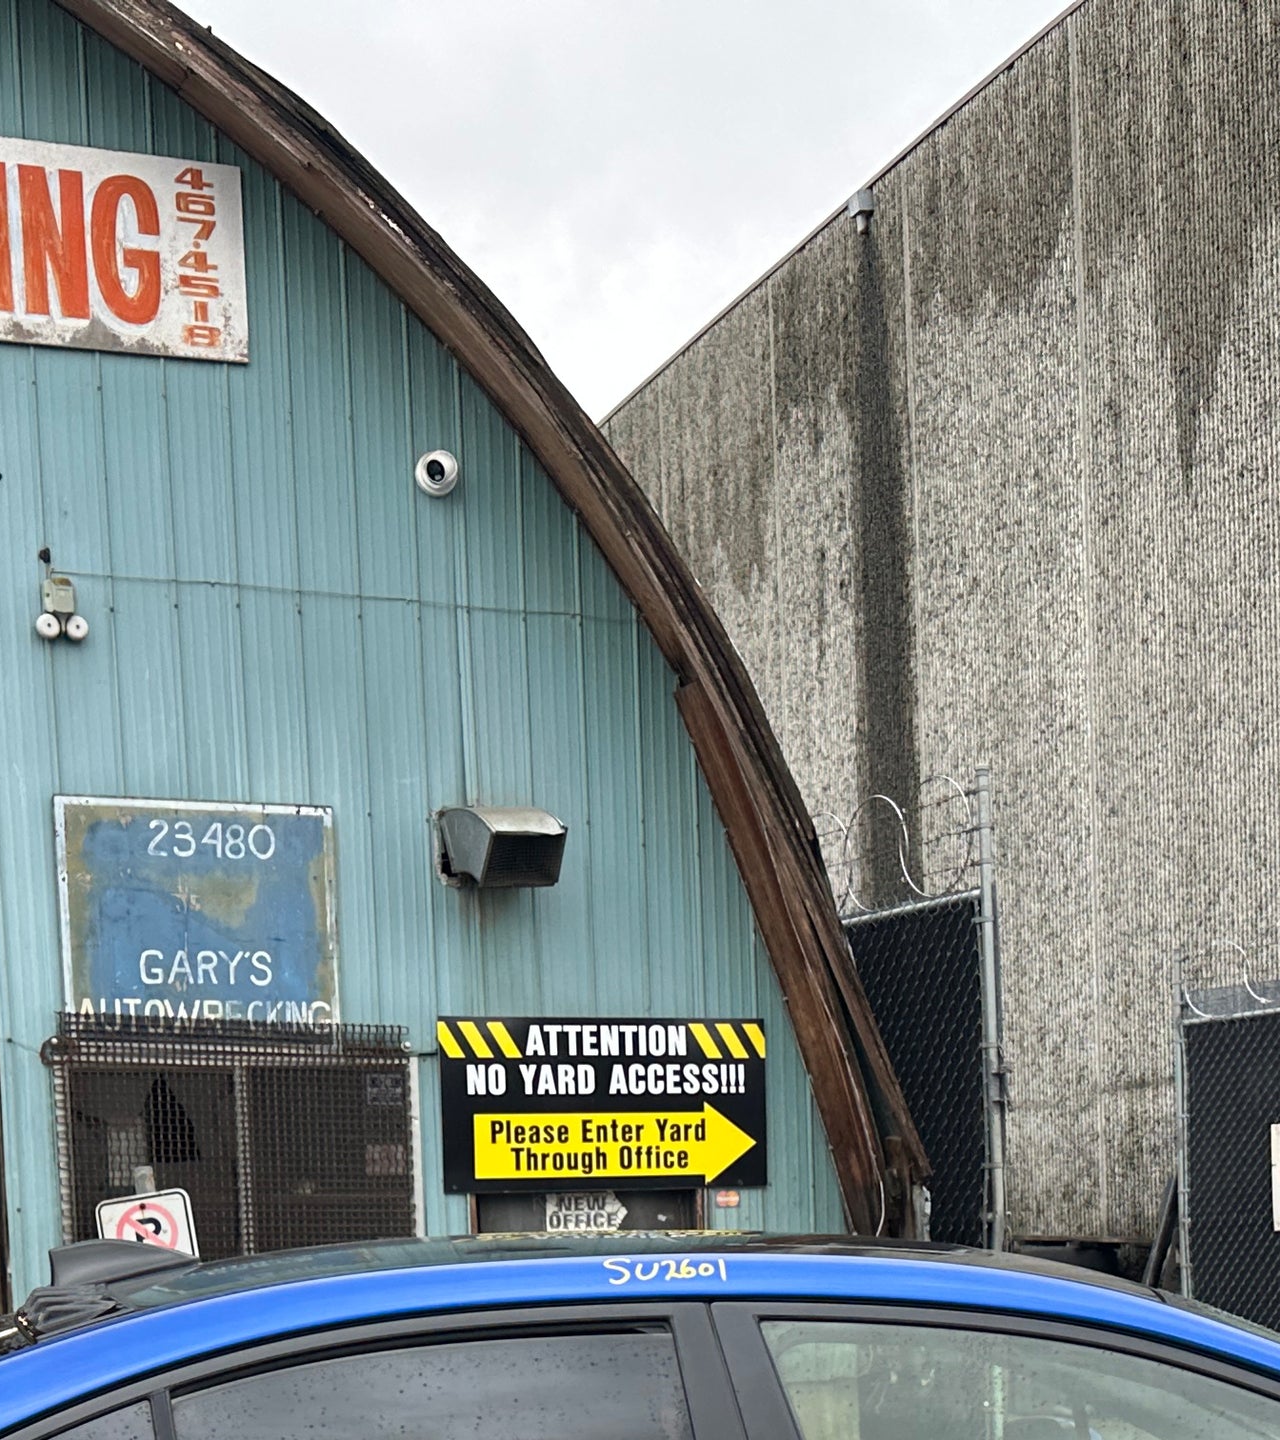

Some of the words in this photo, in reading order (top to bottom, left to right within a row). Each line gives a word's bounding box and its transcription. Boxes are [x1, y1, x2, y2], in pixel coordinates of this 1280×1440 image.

[146, 818, 277, 862] 23480
[139, 948, 274, 987] GARY'S
[524, 1024, 688, 1057] ATTENTION
[465, 1063, 507, 1096] NO
[519, 1063, 596, 1096] YARD
[608, 1063, 746, 1095] ACCESS!!!
[490, 1119, 570, 1145] Please
[581, 1119, 645, 1144] Enter
[655, 1117, 707, 1143] Yard
[510, 1146, 608, 1175] Through
[619, 1145, 690, 1170] Office
[557, 1194, 608, 1212] NEW
[548, 1211, 619, 1230] OFFICE
[602, 1257, 729, 1286] SU2601
